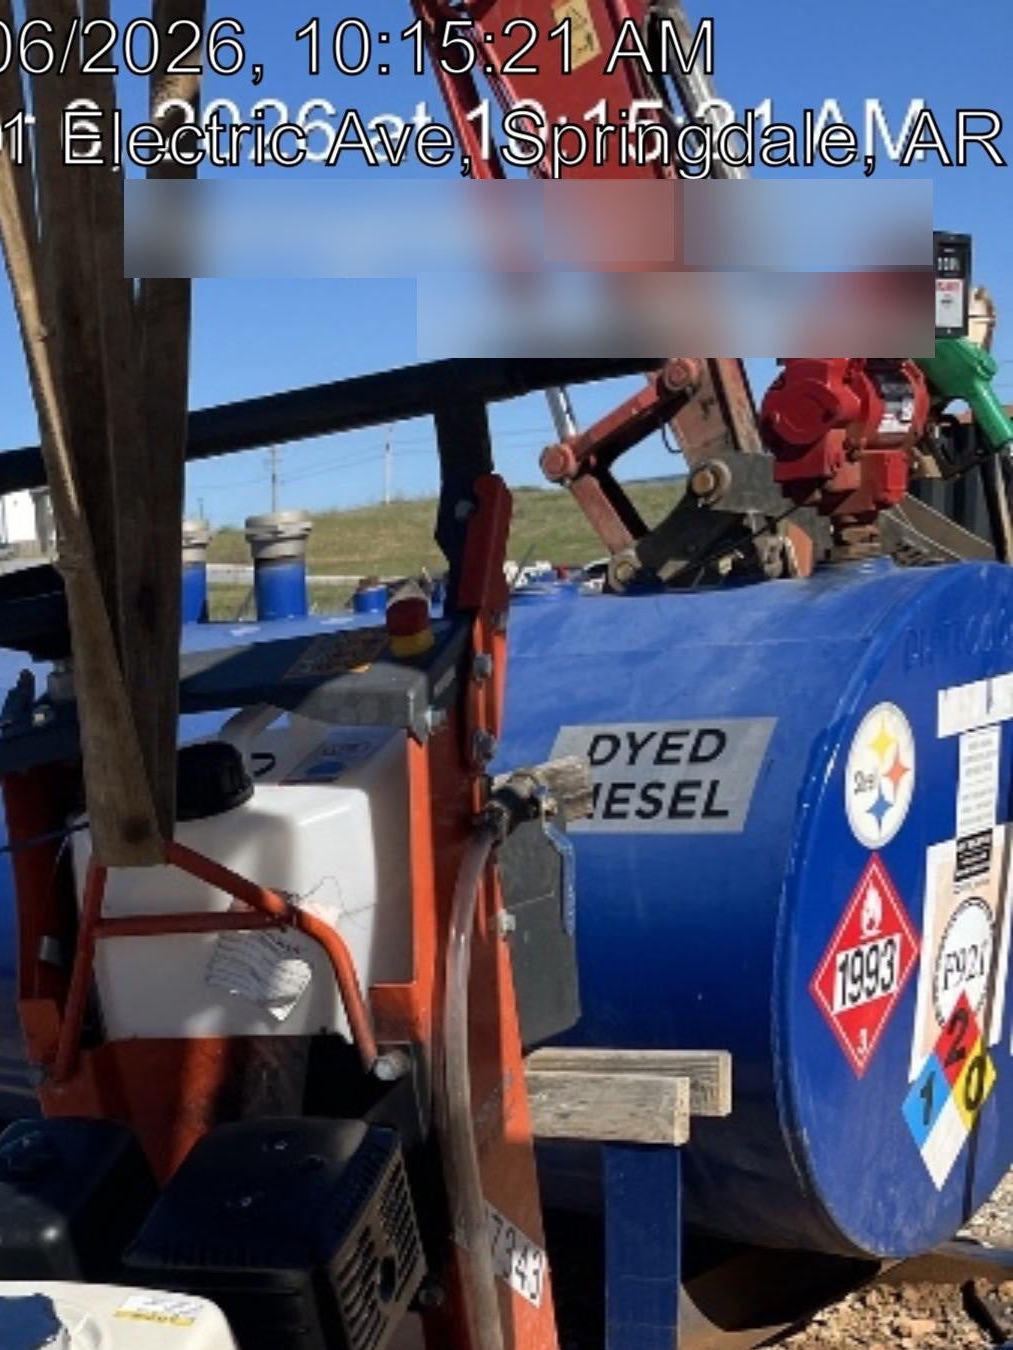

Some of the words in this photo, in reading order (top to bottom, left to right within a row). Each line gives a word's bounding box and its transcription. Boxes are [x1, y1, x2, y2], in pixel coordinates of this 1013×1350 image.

[587, 728, 727, 766] DYED
[588, 779, 729, 819] IESEL
[838, 938, 897, 1006] 1993
[857, 1028, 869, 1054] 3
[944, 1008, 969, 1069] 2
[920, 1071, 936, 1126] 1
[965, 1055, 987, 1111] 0
